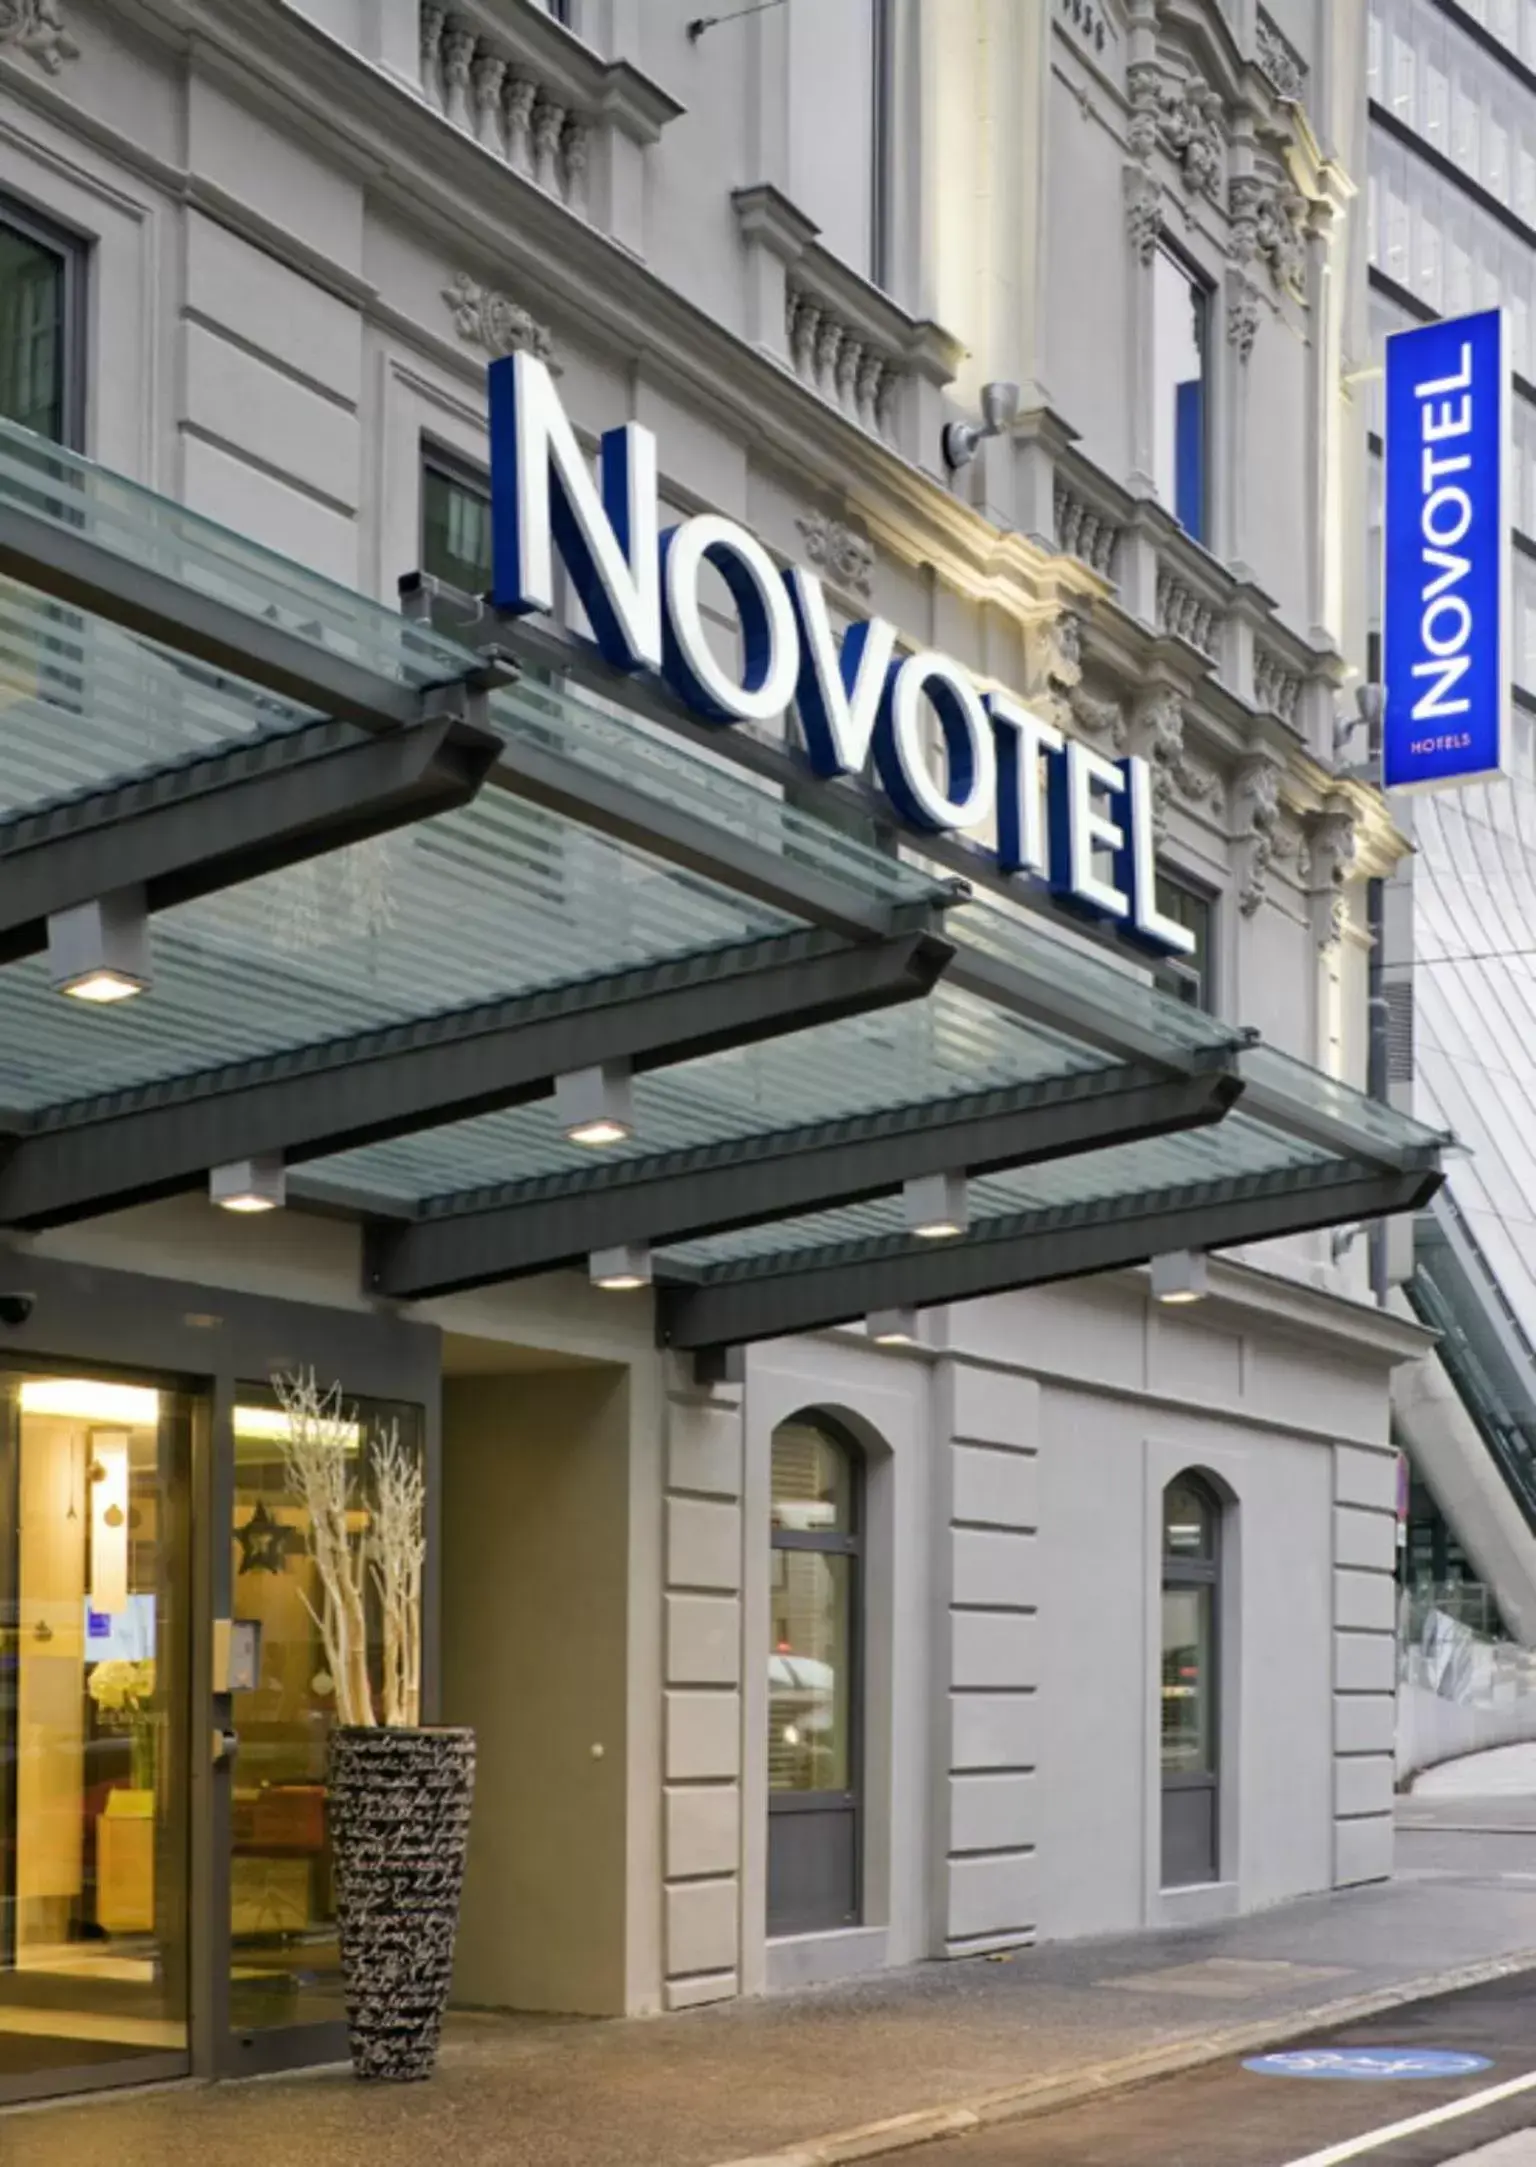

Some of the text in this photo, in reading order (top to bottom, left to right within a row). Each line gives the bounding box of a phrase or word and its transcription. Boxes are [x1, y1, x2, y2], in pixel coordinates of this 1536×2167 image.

[488, 349, 1196, 956] NOVOTEL
[1411, 342, 1472, 720] NOVOTEL
[1411, 732, 1472, 755] HOTELS
